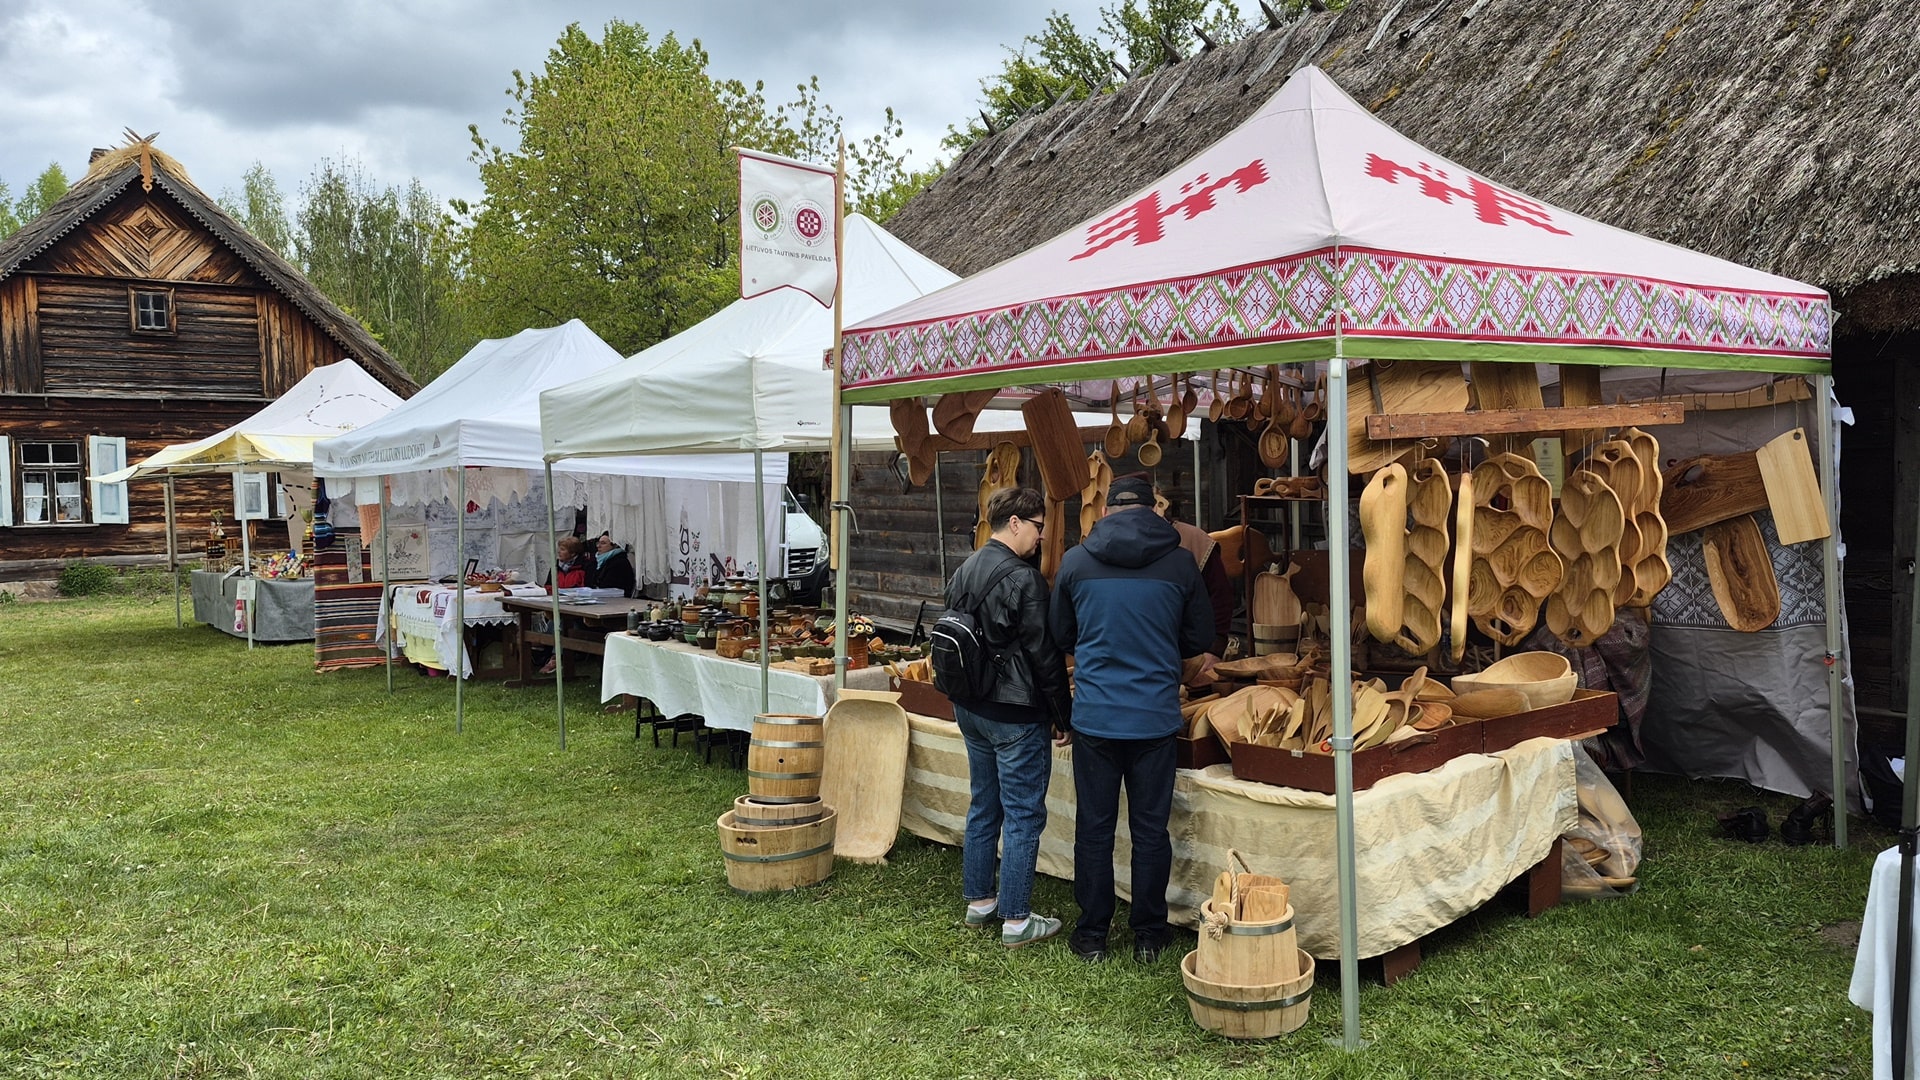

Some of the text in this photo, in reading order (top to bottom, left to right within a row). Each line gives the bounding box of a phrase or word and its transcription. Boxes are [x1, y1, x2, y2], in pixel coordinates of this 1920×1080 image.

[745, 244, 831, 262] LIETUVOS TAUTINIS PAVELDAS
